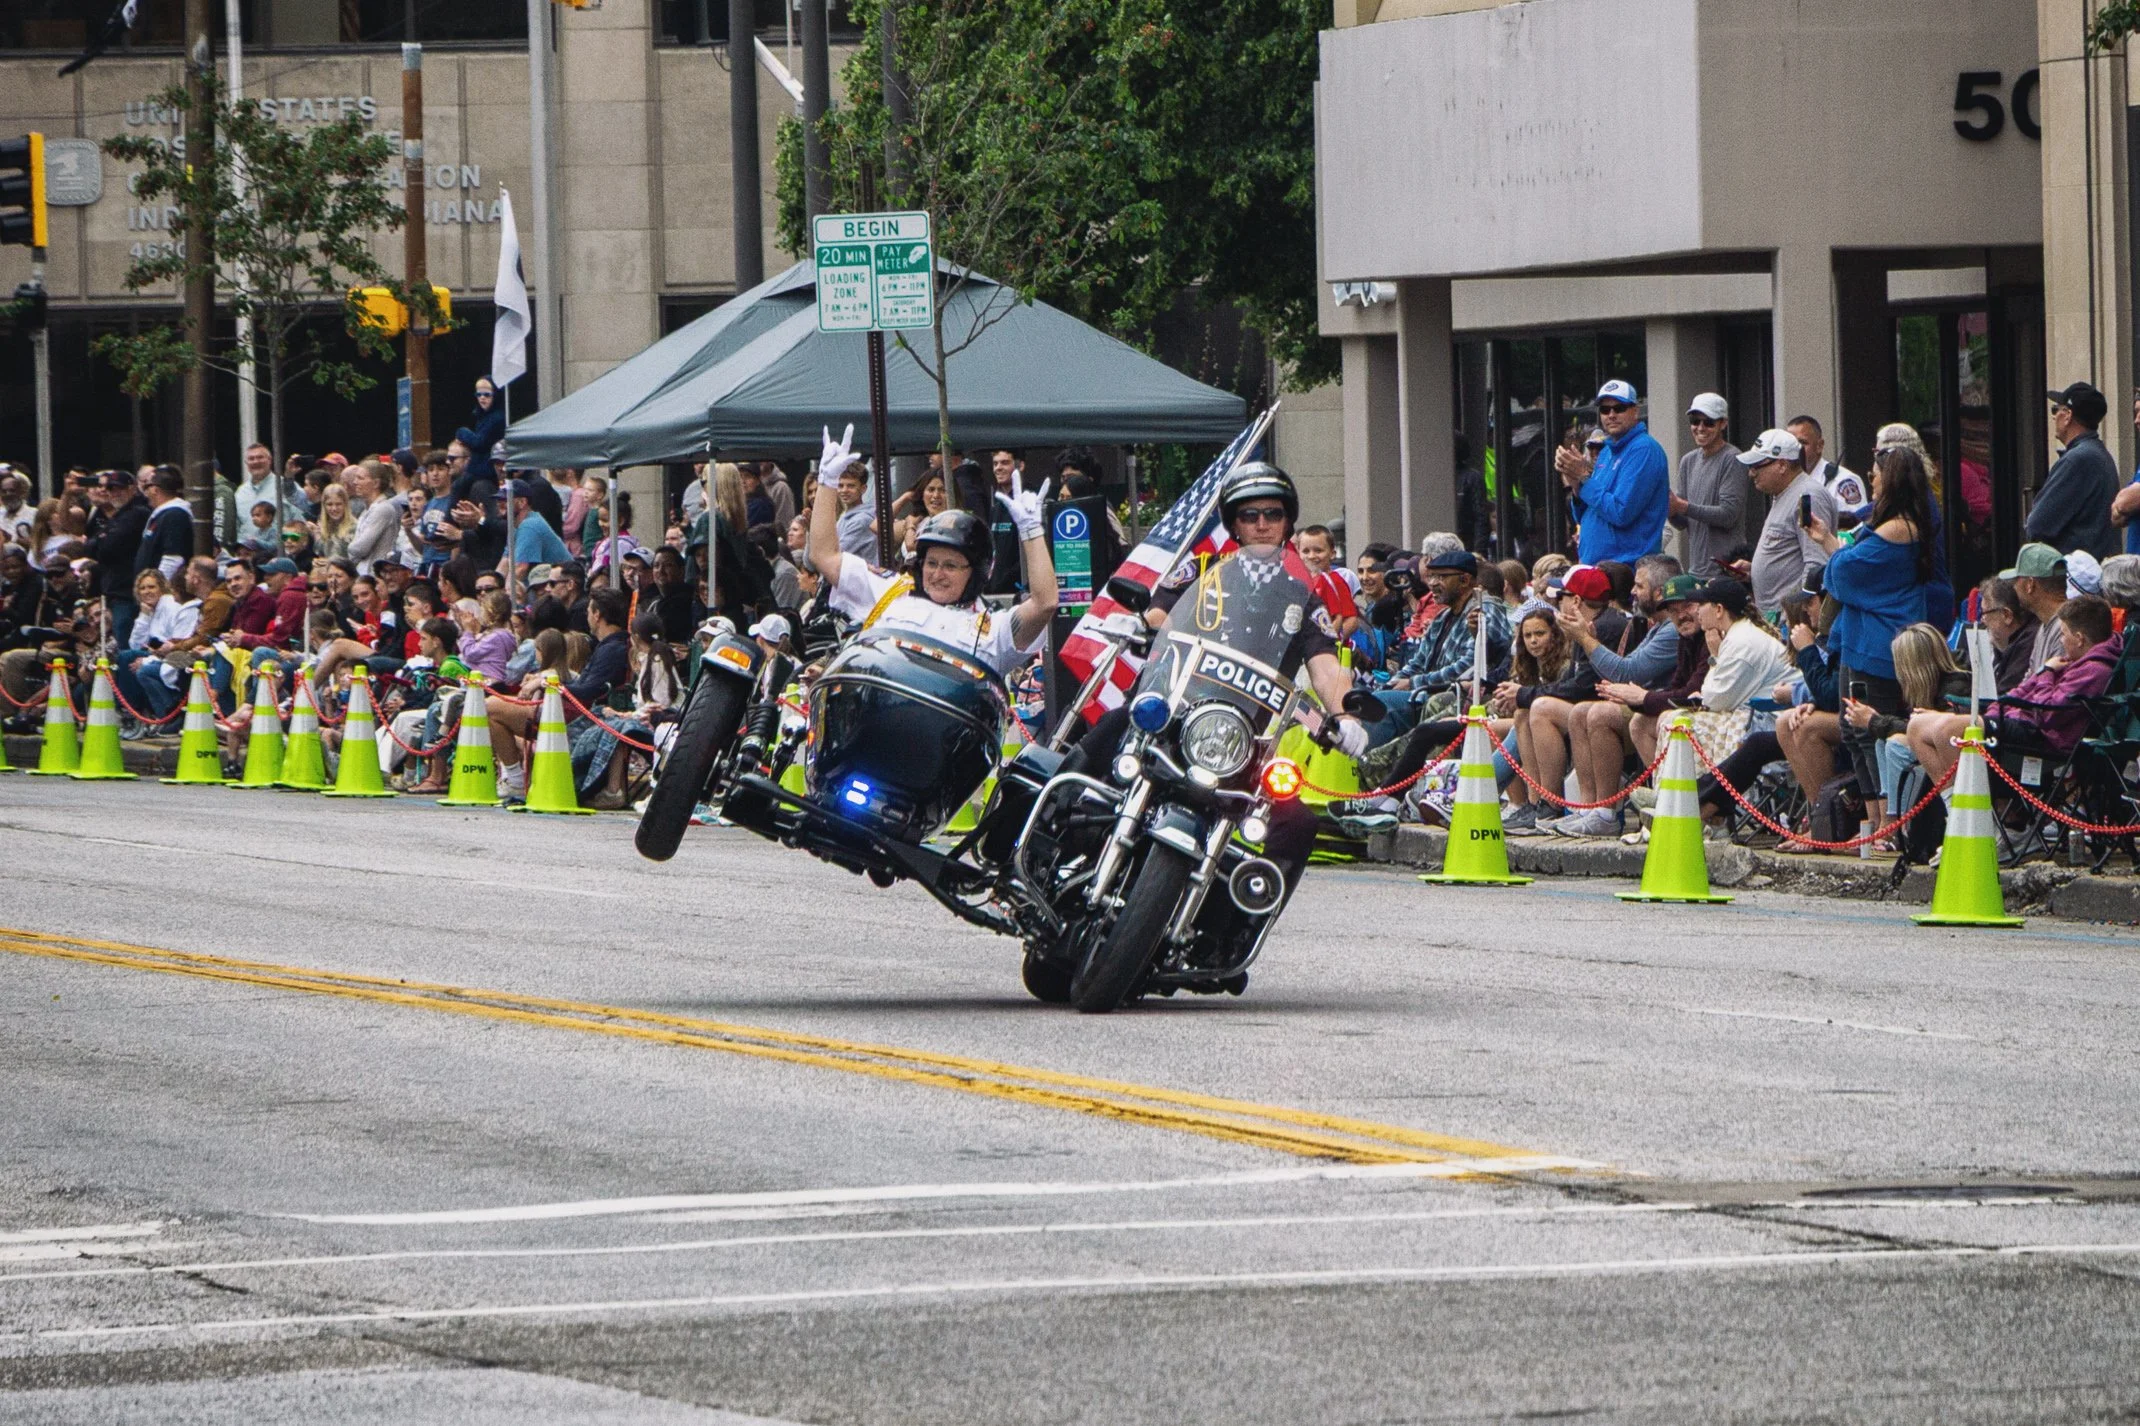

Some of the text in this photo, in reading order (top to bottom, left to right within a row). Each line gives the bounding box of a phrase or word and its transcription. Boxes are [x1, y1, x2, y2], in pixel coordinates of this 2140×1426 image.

[258, 96, 377, 123] STATES
[844, 219, 899, 237] BEGIN
[821, 248, 867, 264] 20 MIN
[882, 246, 901, 257] PAY
[876, 257, 908, 270] METER
[824, 272, 865, 285] LOADING
[833, 287, 857, 299] ZONE
[1065, 514, 1079, 534] P
[1200, 653, 1286, 711] POLICE
[462, 764, 488, 774] DPW
[1470, 829, 1501, 840] DPW
